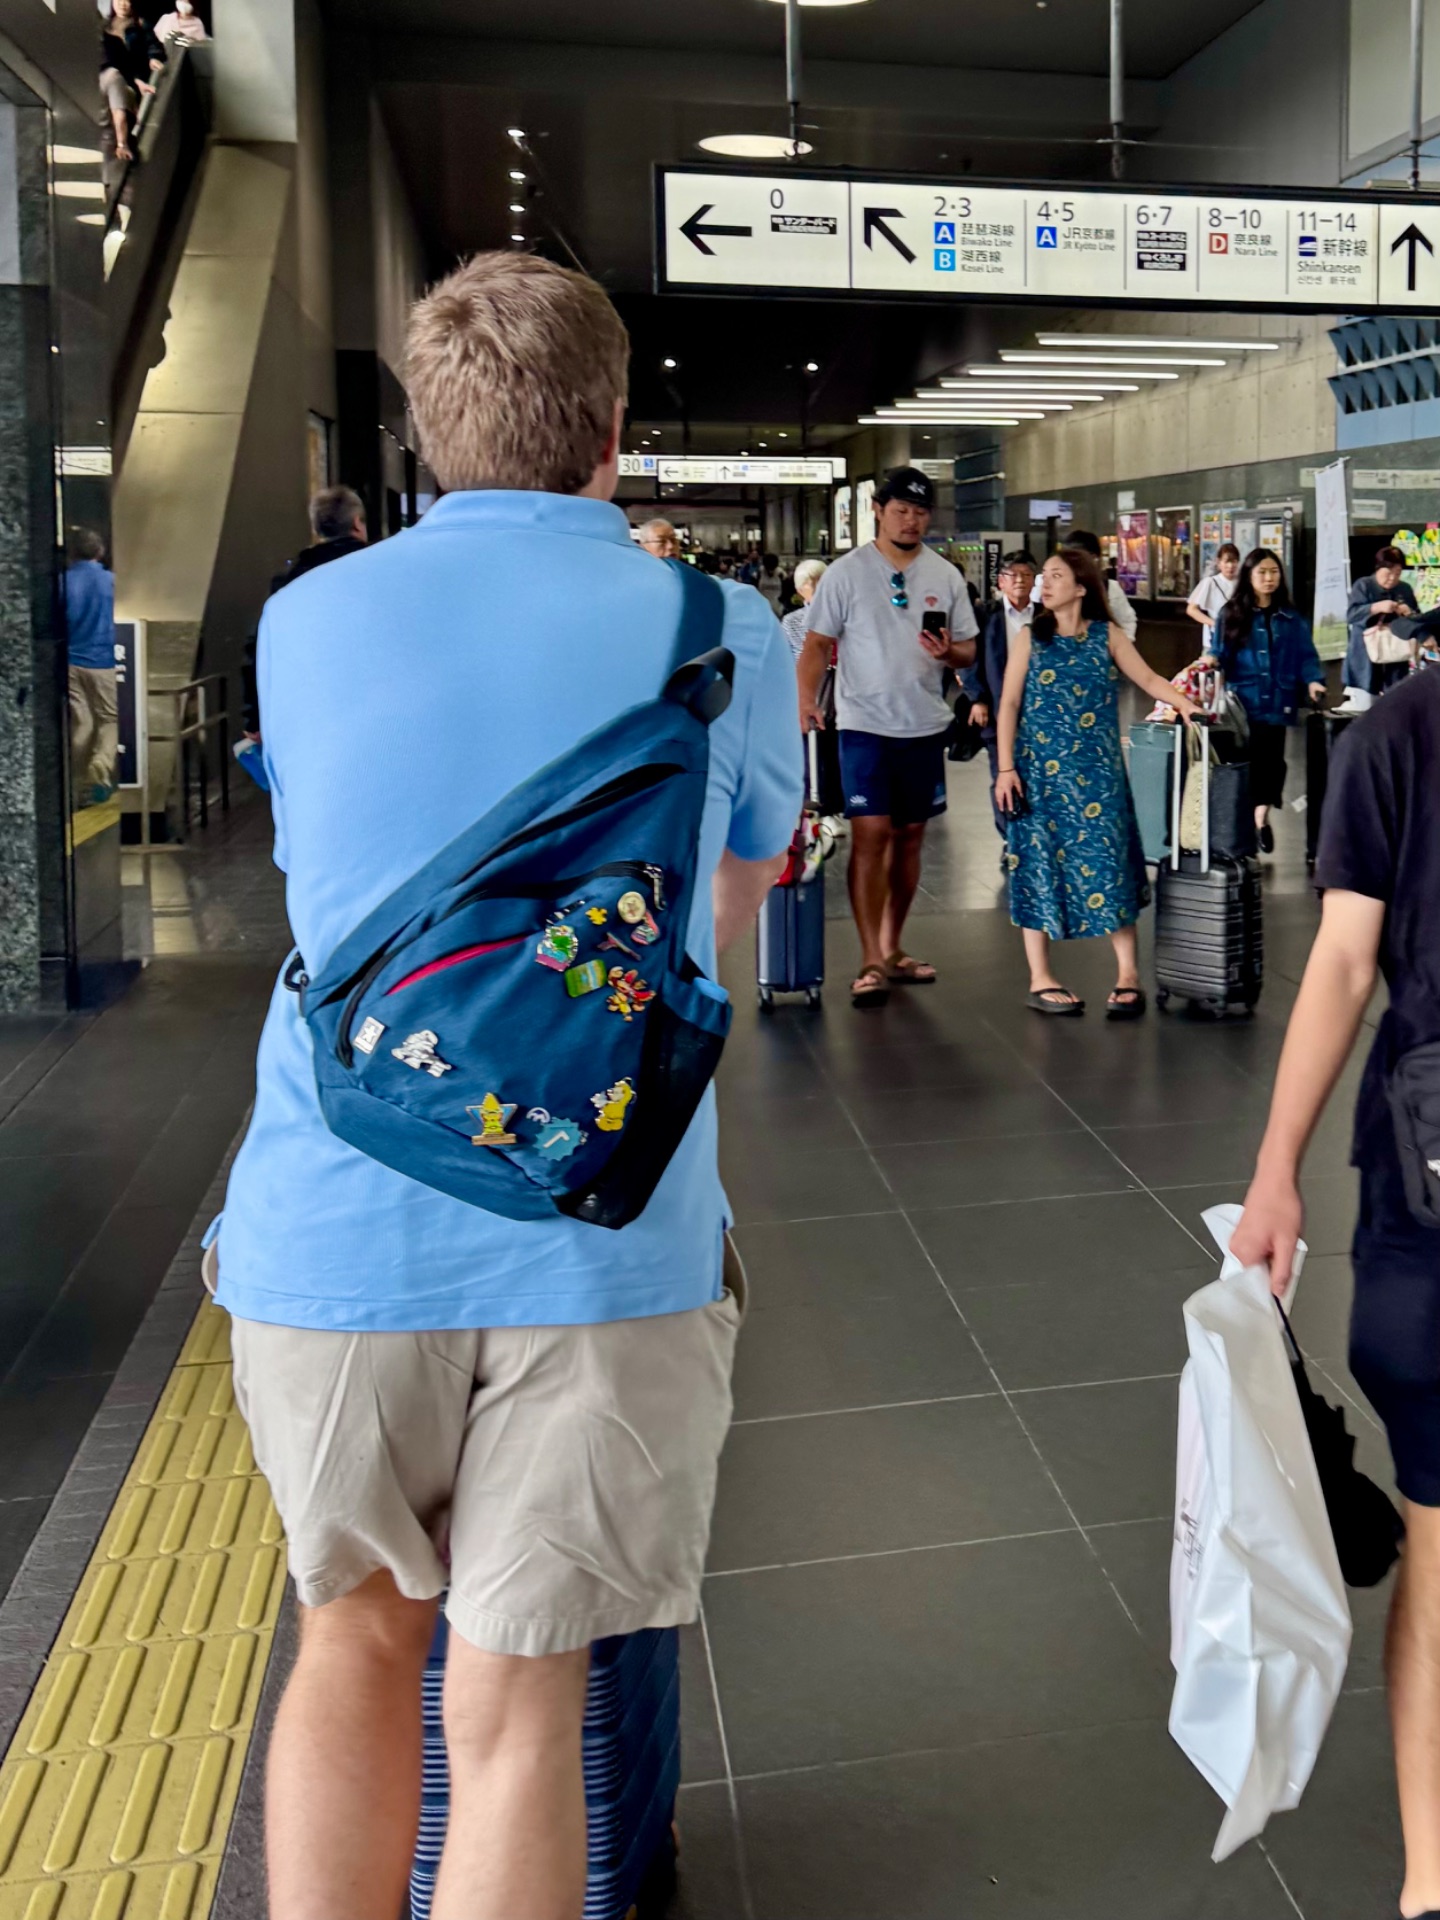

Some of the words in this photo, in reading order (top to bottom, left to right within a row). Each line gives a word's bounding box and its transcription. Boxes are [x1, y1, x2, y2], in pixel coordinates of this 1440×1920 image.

[770, 188, 784, 209] 0
[936, 224, 954, 242] A
[1038, 228, 1055, 246] A
[1211, 235, 1227, 252] D
[1322, 239, 1369, 257] 新幹線
[938, 251, 952, 269] B
[1297, 260, 1362, 274] Shinkansen
[621, 458, 641, 473] 30
